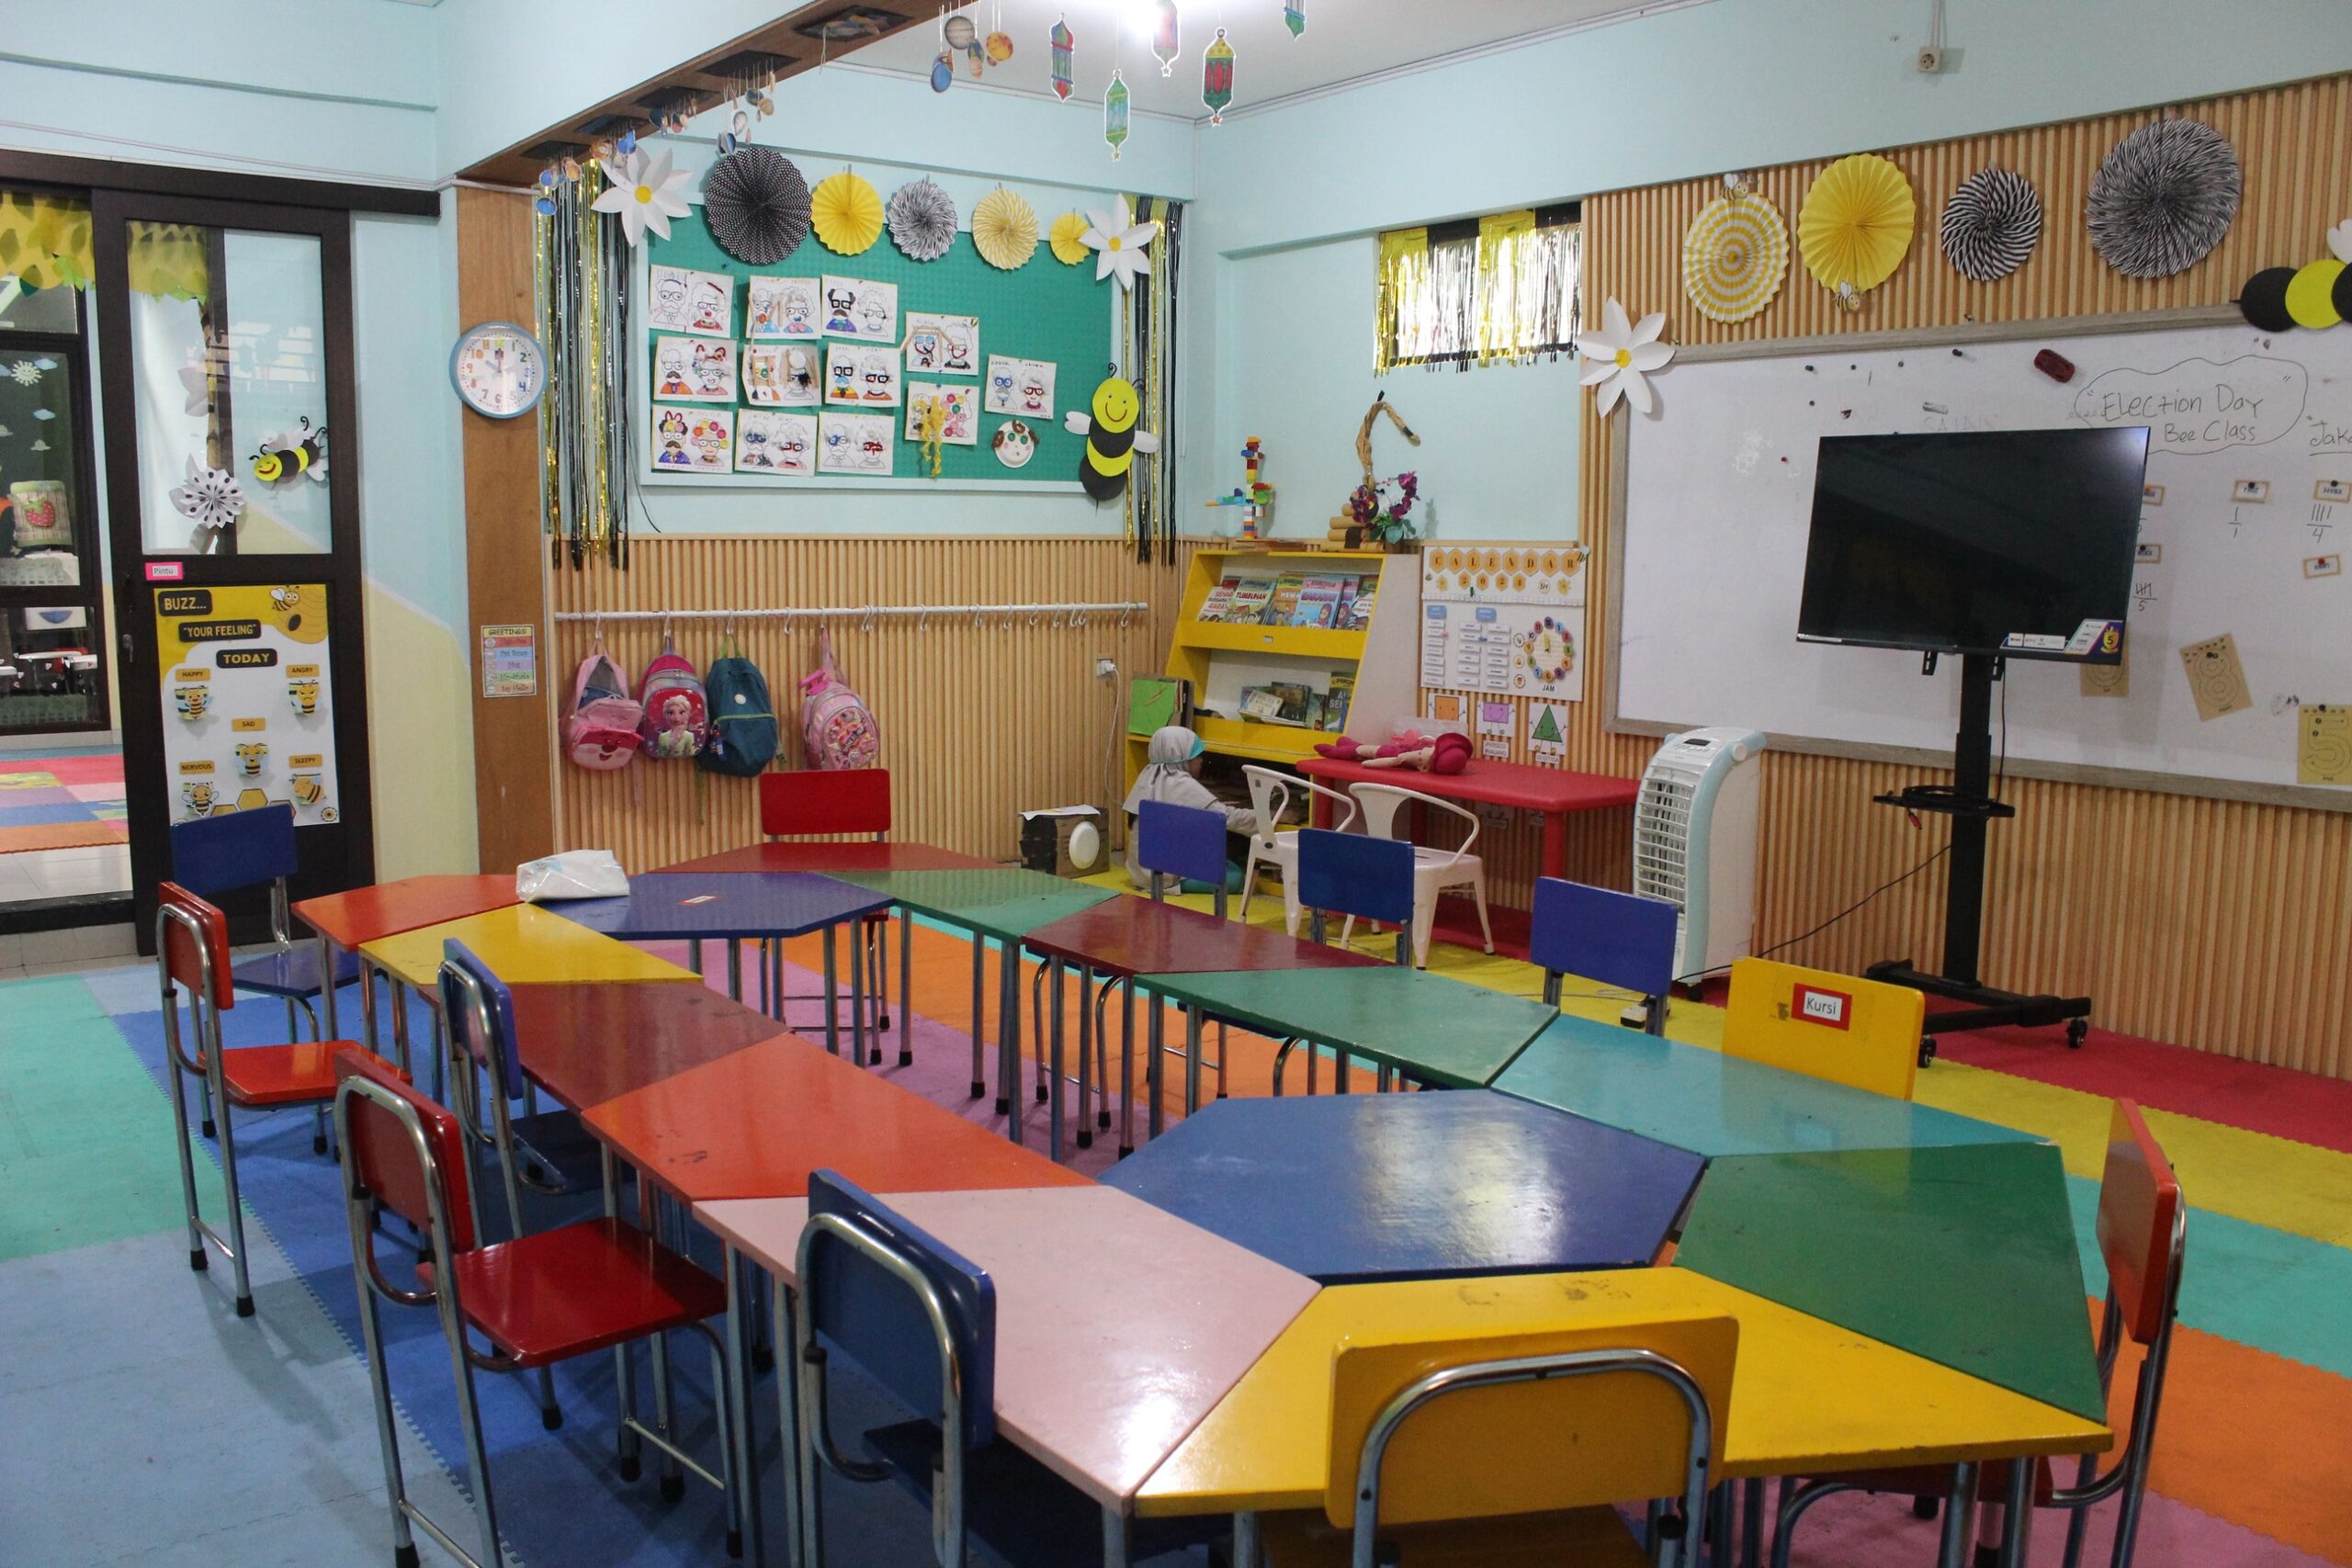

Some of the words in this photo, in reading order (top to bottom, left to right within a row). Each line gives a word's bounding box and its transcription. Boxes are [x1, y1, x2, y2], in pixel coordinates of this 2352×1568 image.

[2102, 389, 2201, 422] Election
[2215, 384, 2264, 418] Day
[2165, 423, 2197, 443] Bee
[2204, 420, 2256, 441] Class
[2312, 528, 2324, 544] 4
[1434, 556, 1574, 569] CALENDAR
[164, 597, 207, 611] BUZZ...
[2138, 600, 2147, 612] 5
[2107, 636, 2114, 645] 5
[223, 652, 270, 664] TODAY
[181, 671, 204, 679] HAPPY
[291, 666, 313, 674] ANGRY
[181, 762, 212, 772] NERVOUS
[294, 757, 315, 765] SLEEPY
[1806, 997, 1837, 1014] Kursi
